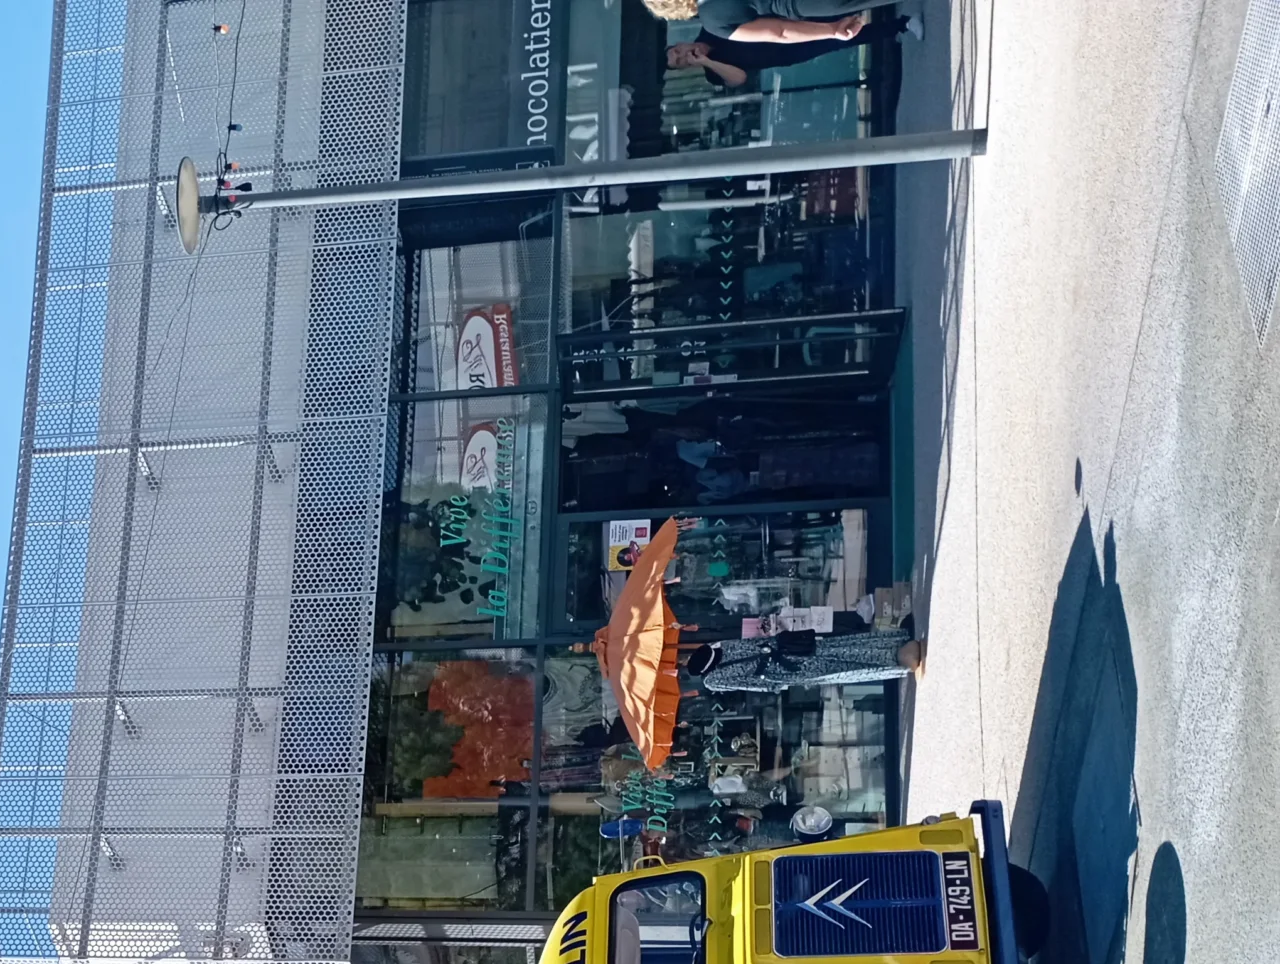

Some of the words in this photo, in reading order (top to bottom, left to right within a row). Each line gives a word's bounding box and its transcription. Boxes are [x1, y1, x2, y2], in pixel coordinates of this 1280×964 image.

[521, 0, 552, 146] hocolatier
[440, 494, 469, 547] Vive
[479, 417, 521, 574] Différence
[477, 589, 507, 617] la
[620, 770, 643, 812] Vive
[945, 860, 975, 941] DA-749-LN
